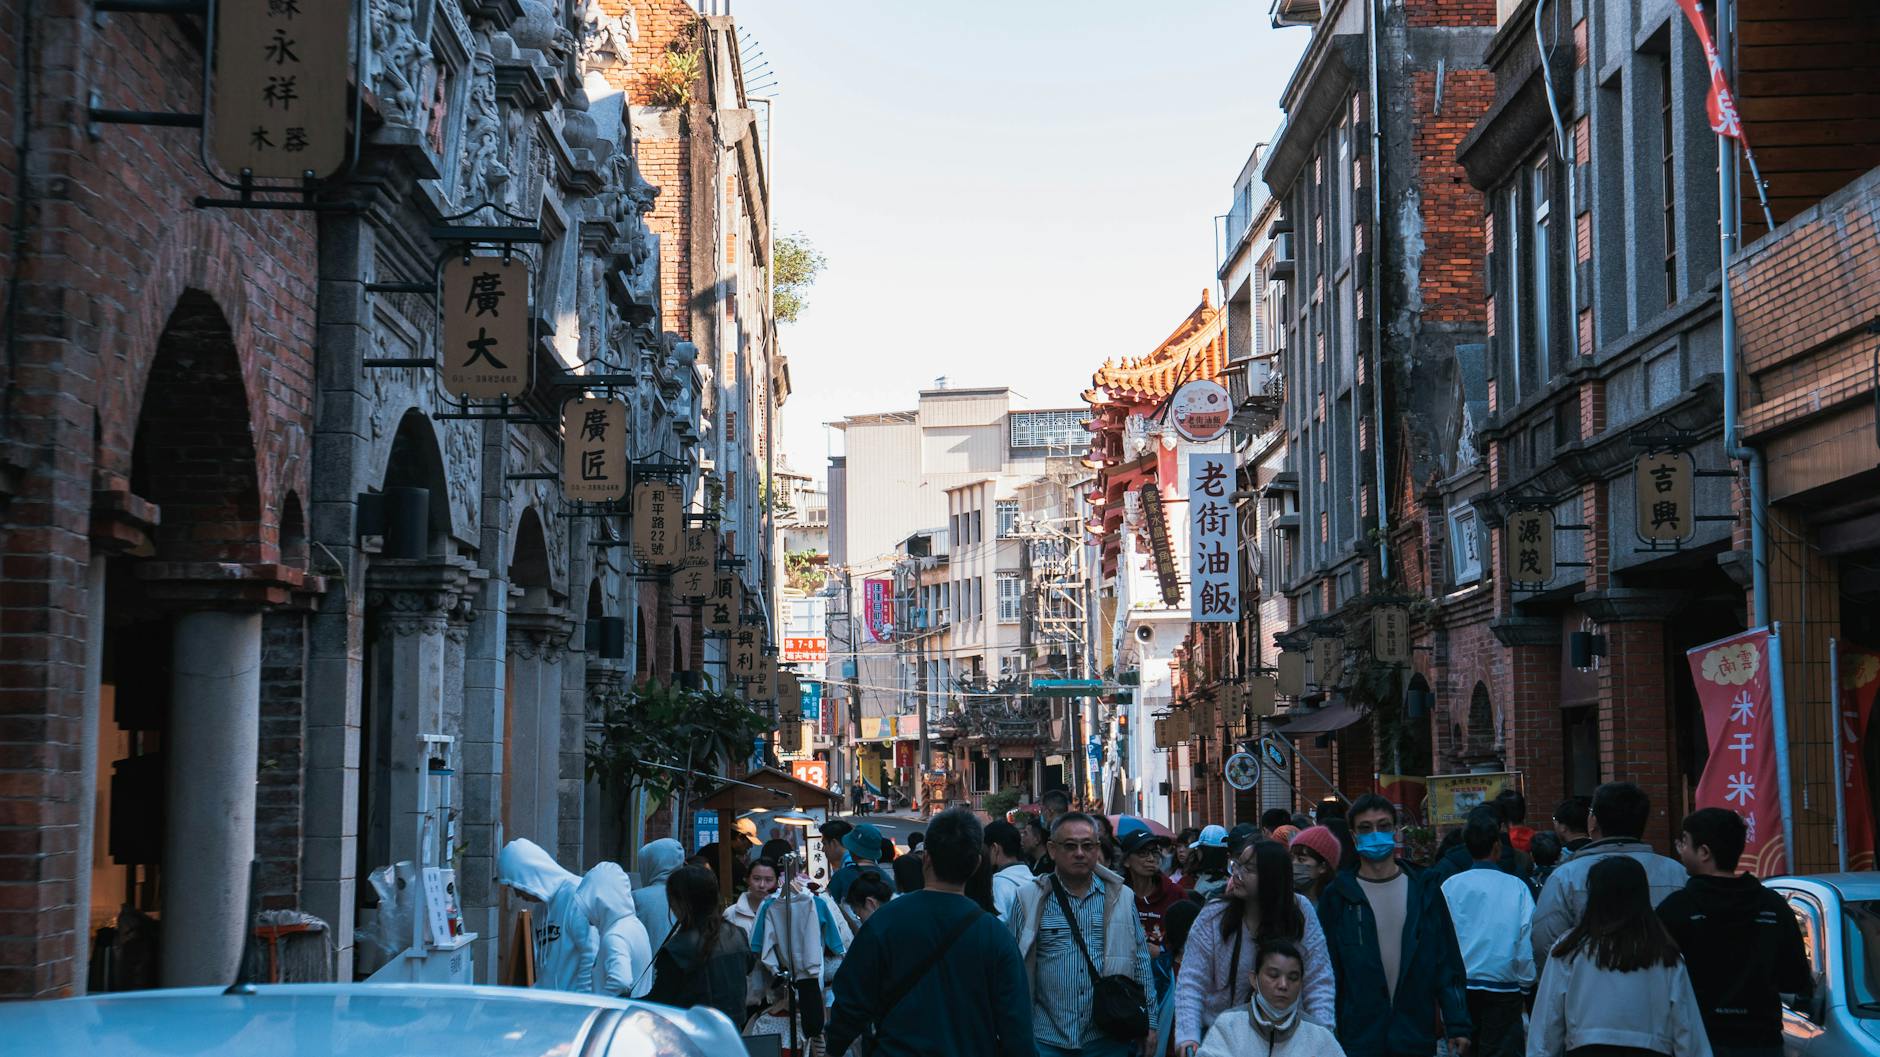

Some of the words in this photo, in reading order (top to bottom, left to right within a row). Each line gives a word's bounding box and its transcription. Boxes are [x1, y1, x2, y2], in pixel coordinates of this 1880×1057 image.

[251, 125, 309, 152] 木器
[462, 272, 508, 369] 廣大
[580, 408, 610, 481] 廣匠
[651, 490, 665, 556] 和平路22號
[1650, 464, 1680, 530] 吉興
[1194, 460, 1234, 616] 老街油飯
[1518, 518, 1542, 575] 源茂
[712, 578, 735, 625] 順益
[737, 631, 755, 671] 興利
[796, 766, 824, 787] 13
